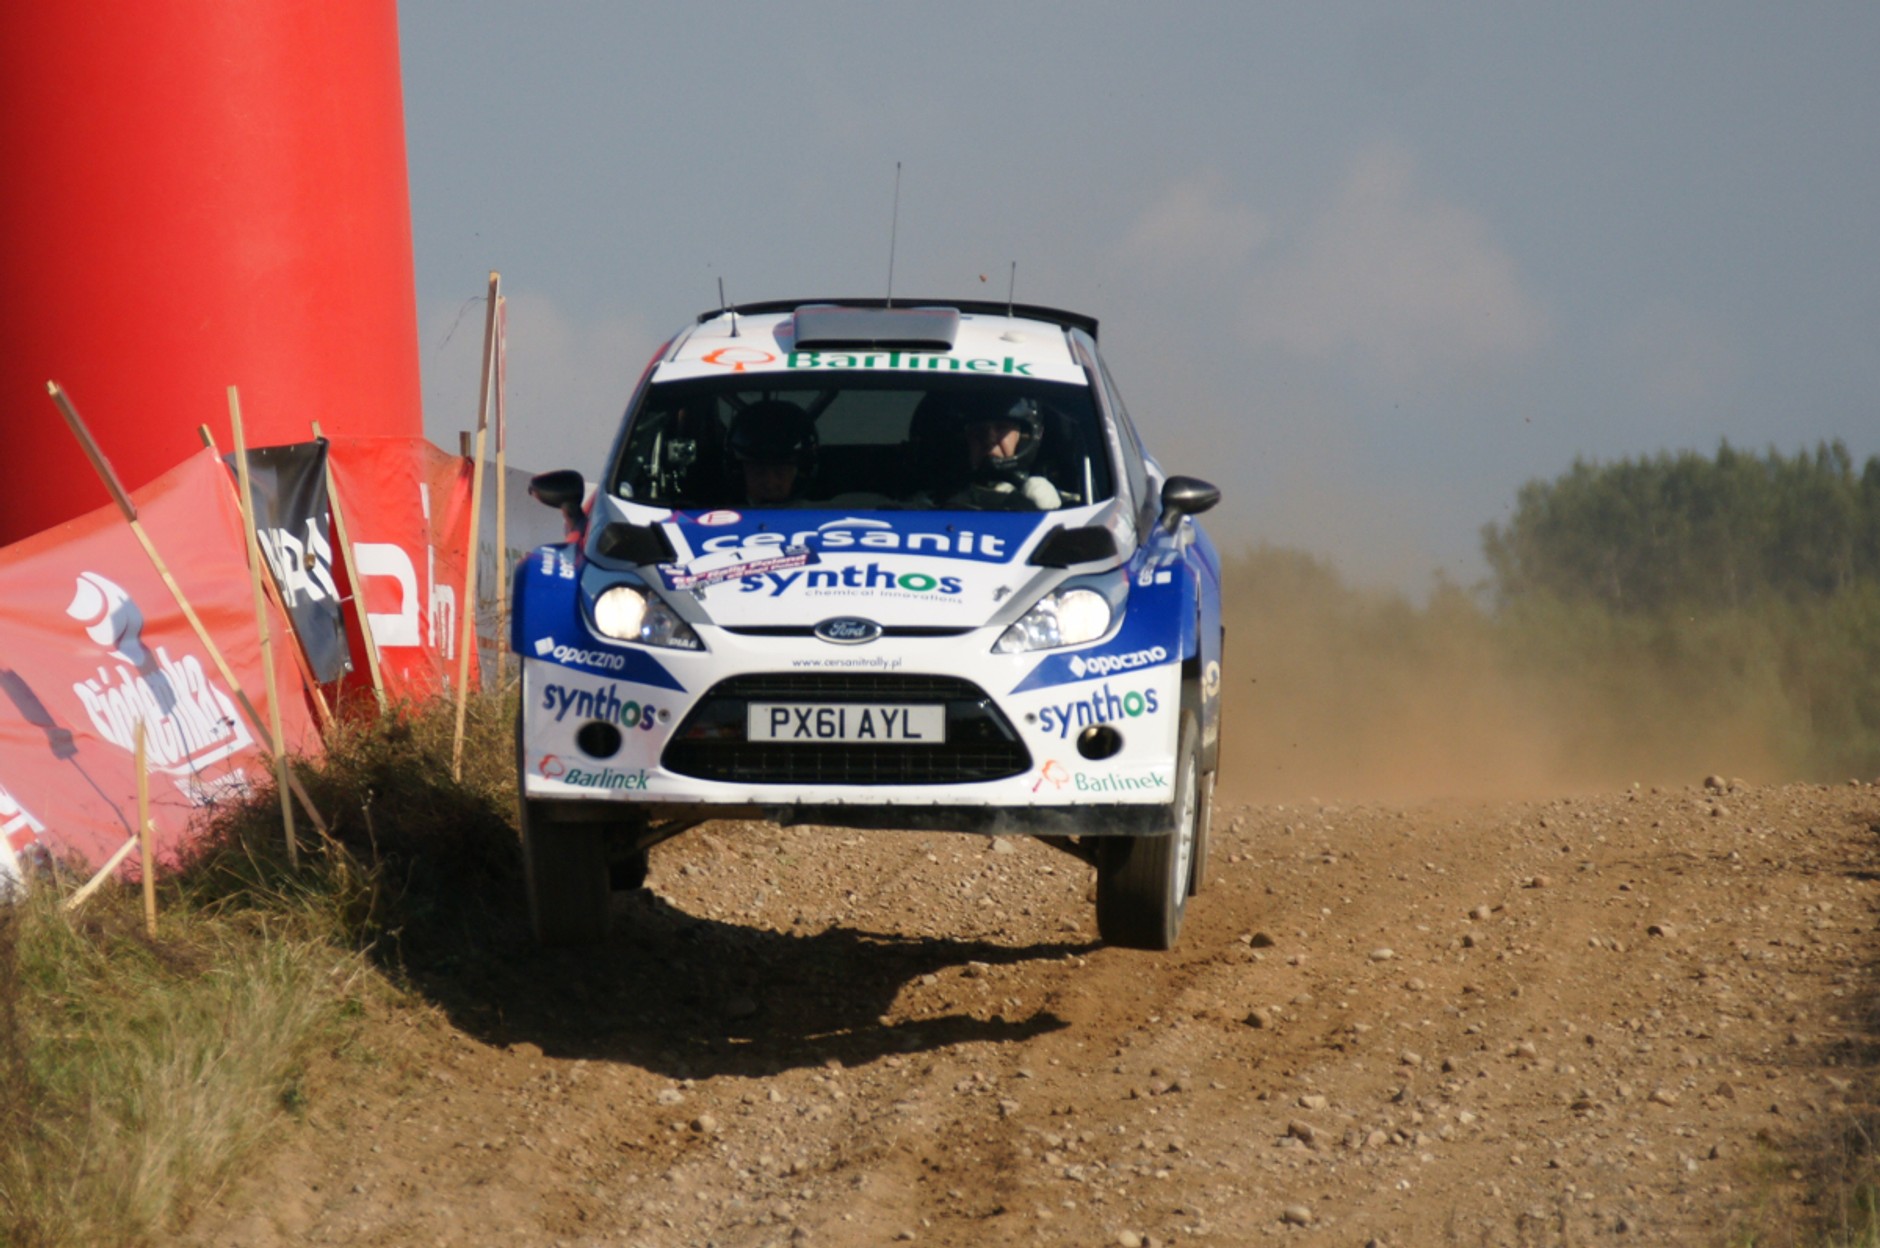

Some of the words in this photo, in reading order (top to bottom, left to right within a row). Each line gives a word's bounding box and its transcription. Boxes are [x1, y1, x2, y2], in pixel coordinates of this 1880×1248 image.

[786, 350, 1033, 376] Barlinek
[701, 527, 1006, 557] cersanit
[740, 563, 963, 598] synthos
[805, 589, 875, 598] chemical
[879, 590, 963, 604] innovations
[828, 619, 866, 638] Ford
[552, 643, 625, 671] opoczno
[791, 655, 902, 670] www.cersanitrally.pl
[1086, 645, 1167, 676] opoczno
[542, 683, 657, 731] synthos
[1039, 683, 1159, 738] synthos
[769, 707, 846, 740] PX61
[856, 707, 922, 740] AYL
[564, 767, 651, 790] Barlinek
[1074, 771, 1169, 792] Barlinek
